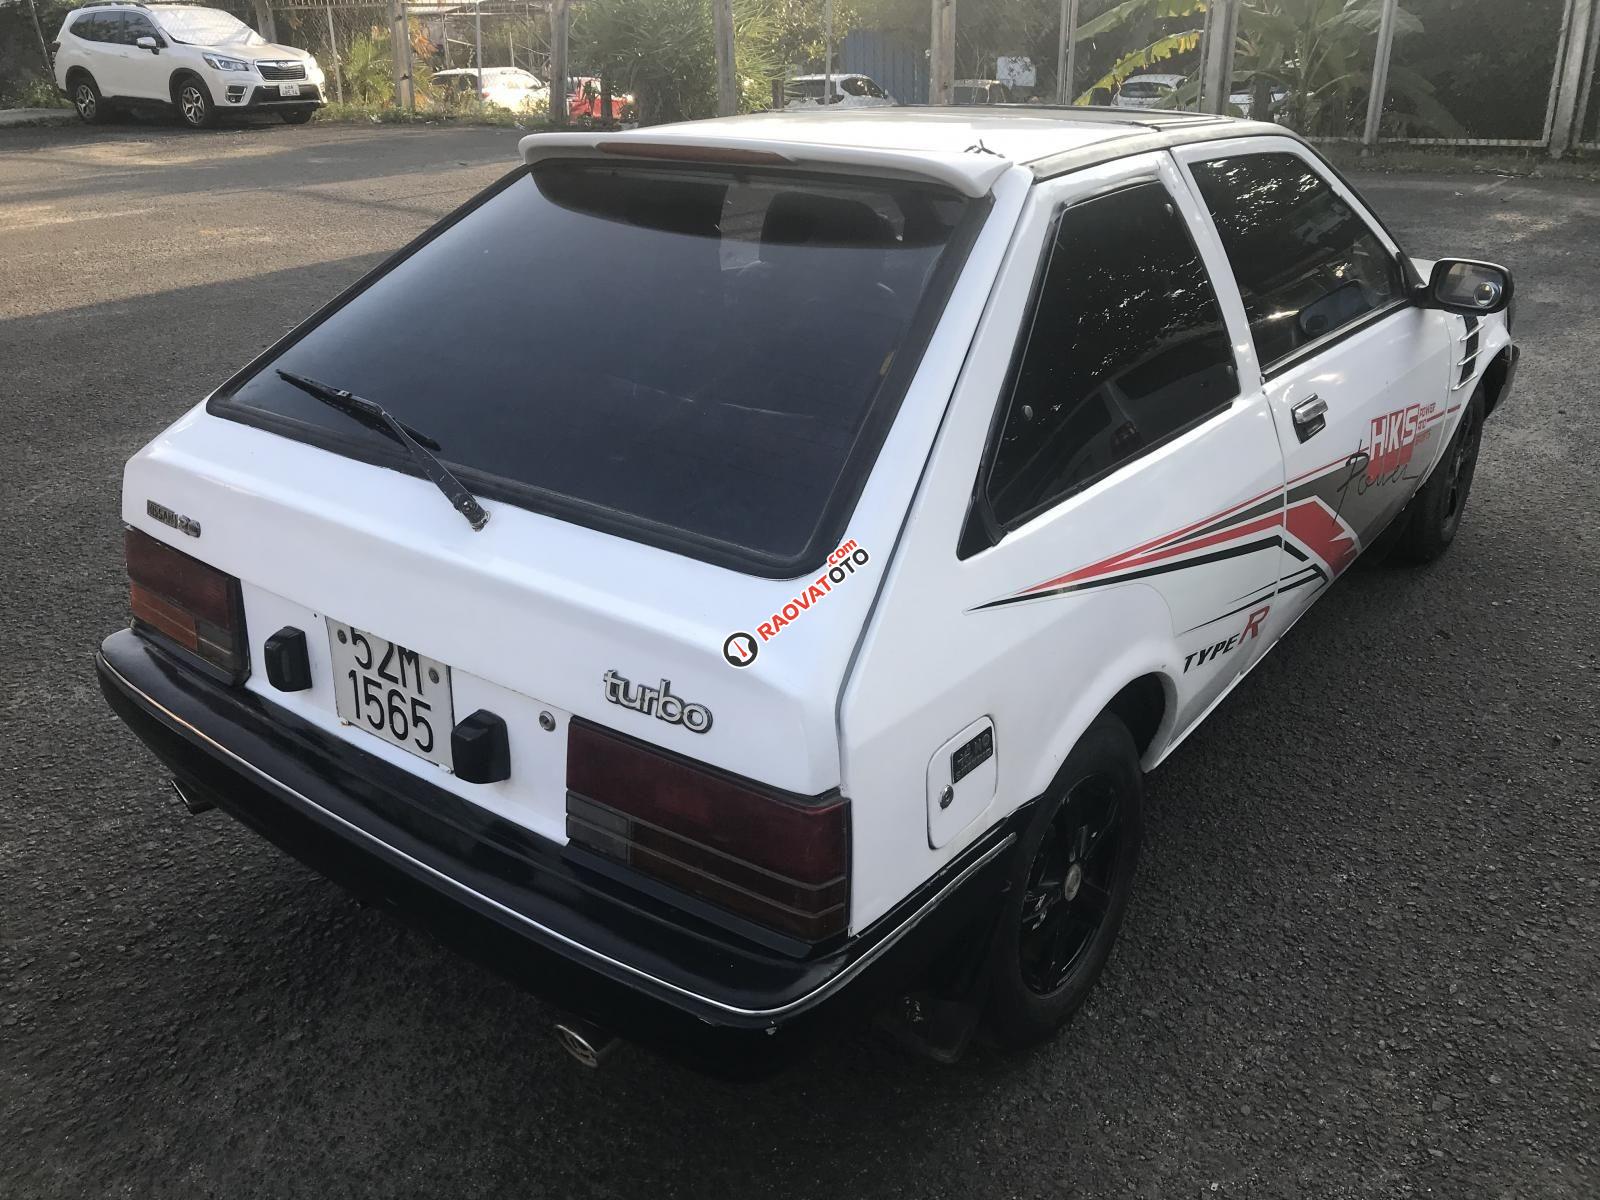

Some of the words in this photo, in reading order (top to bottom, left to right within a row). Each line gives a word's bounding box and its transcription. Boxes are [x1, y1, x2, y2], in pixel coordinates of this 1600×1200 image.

[1370, 405, 1420, 461] HKS
[349, 626, 424, 696] 52M
[1183, 632, 1241, 674] TYPE
[1237, 605, 1271, 646] R
[348, 669, 434, 753] 1565
[602, 669, 714, 734] turbo
